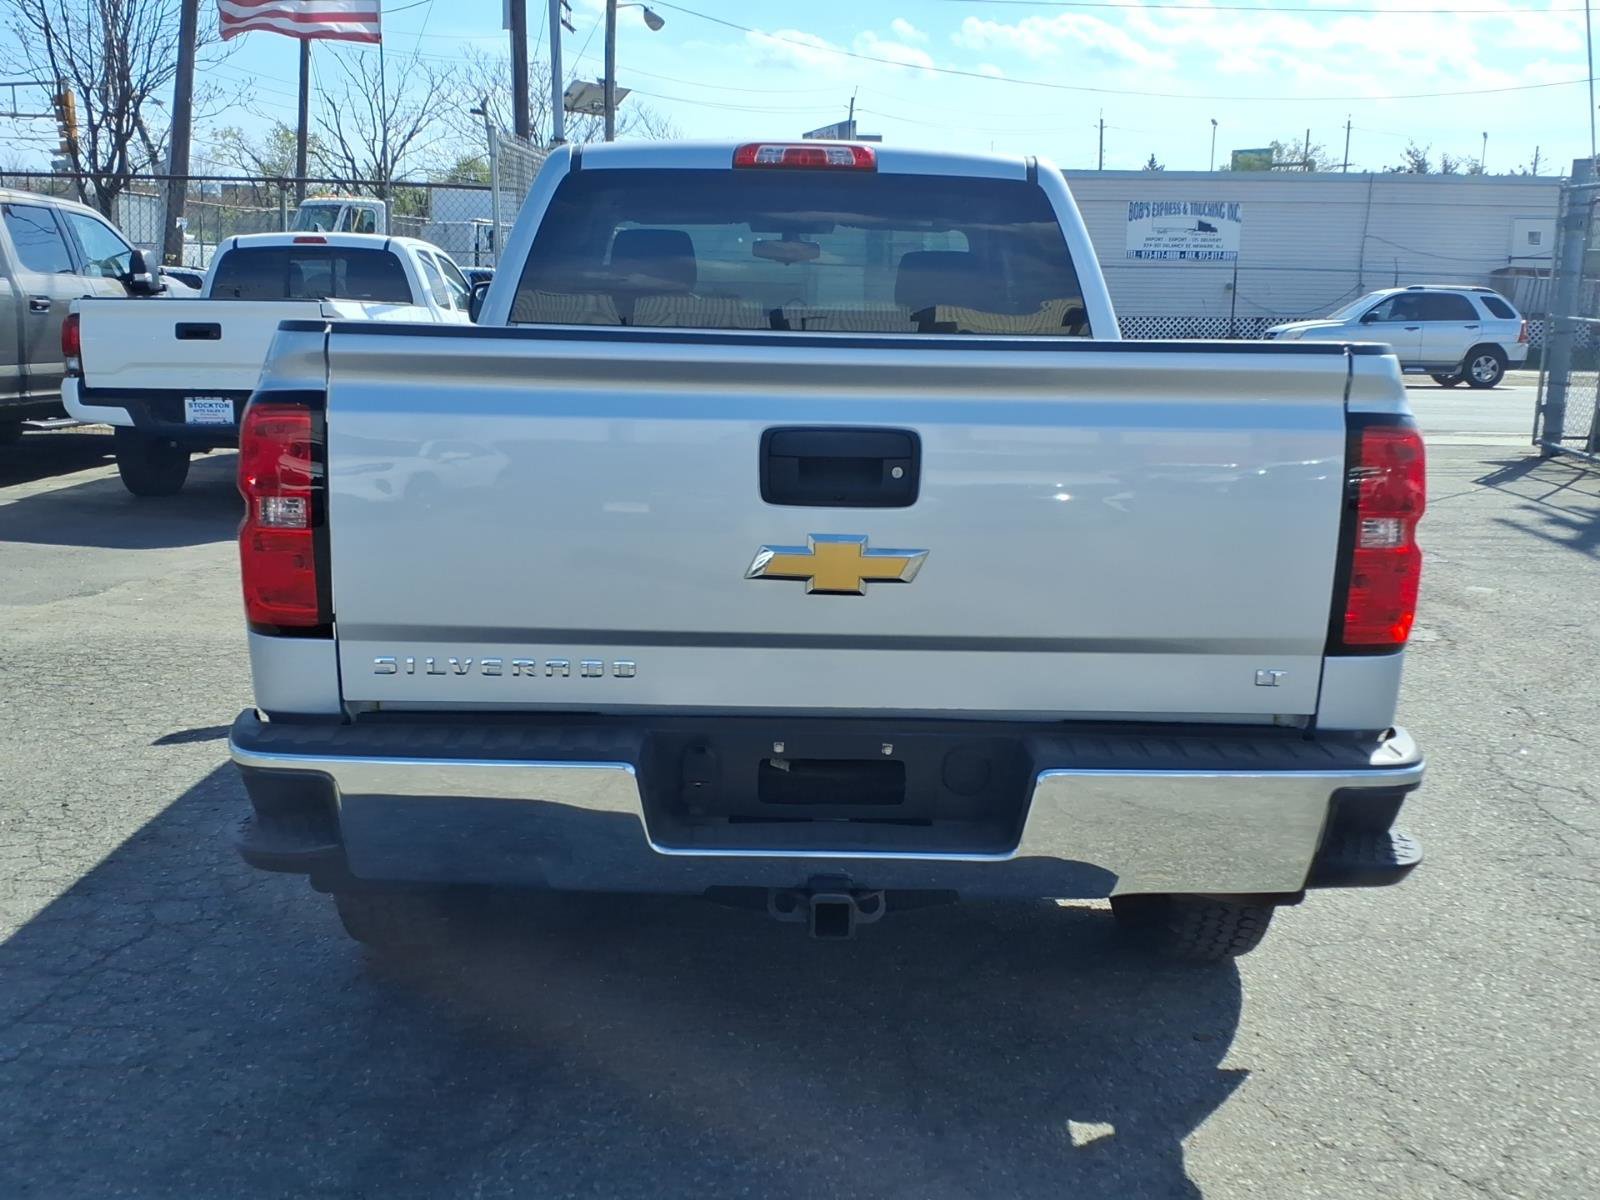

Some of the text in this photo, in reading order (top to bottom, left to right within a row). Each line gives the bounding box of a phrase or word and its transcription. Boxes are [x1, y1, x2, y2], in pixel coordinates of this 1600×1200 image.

[1128, 201, 1151, 222] BOB'S
[1152, 202, 1182, 217] EXPRESS
[1183, 202, 1188, 215] &
[1190, 202, 1226, 220] TRUCKING
[374, 656, 637, 678] SILVERADO
[1255, 669, 1288, 687] LT
